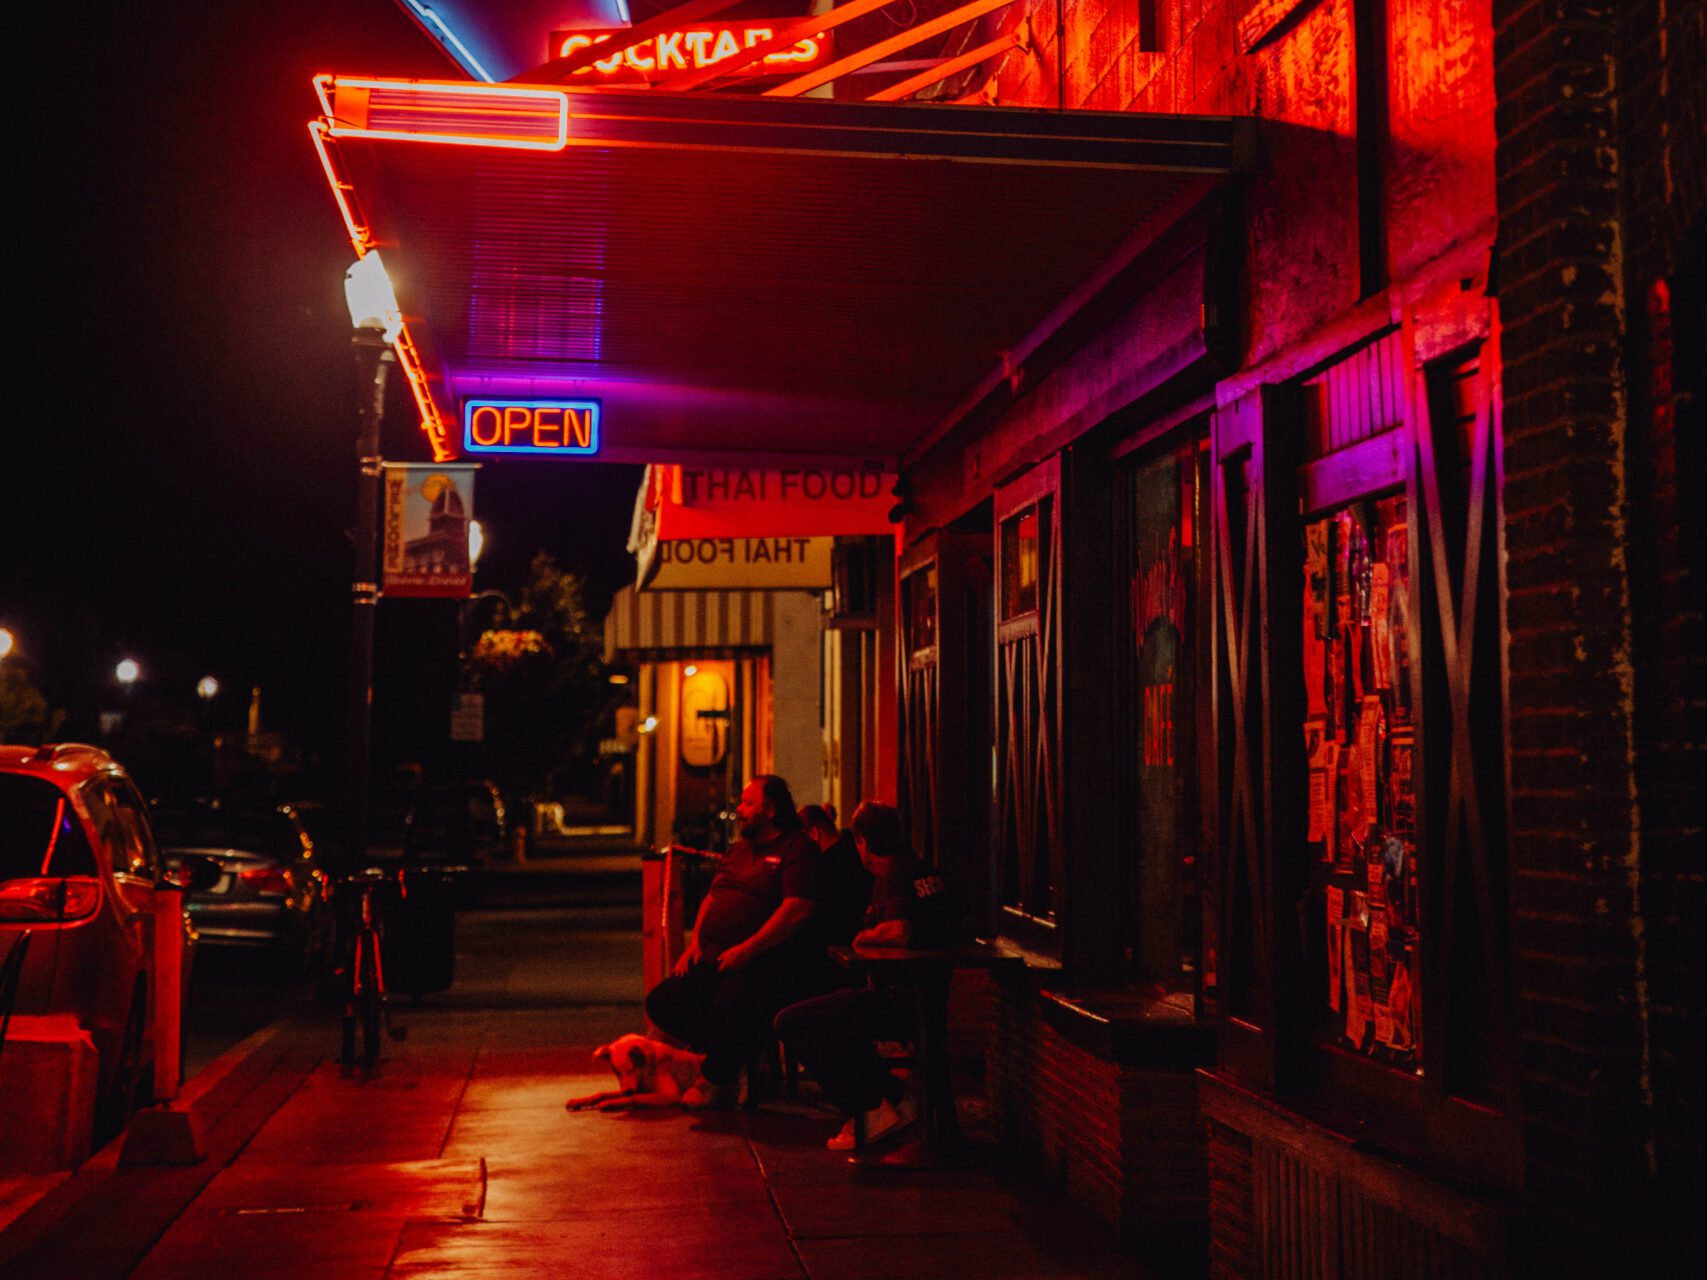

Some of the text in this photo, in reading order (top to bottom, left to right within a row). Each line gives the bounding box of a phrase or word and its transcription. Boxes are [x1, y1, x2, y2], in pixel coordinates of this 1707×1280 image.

[471, 405, 591, 448] OPEN
[684, 468, 882, 501] THAI FOOD
